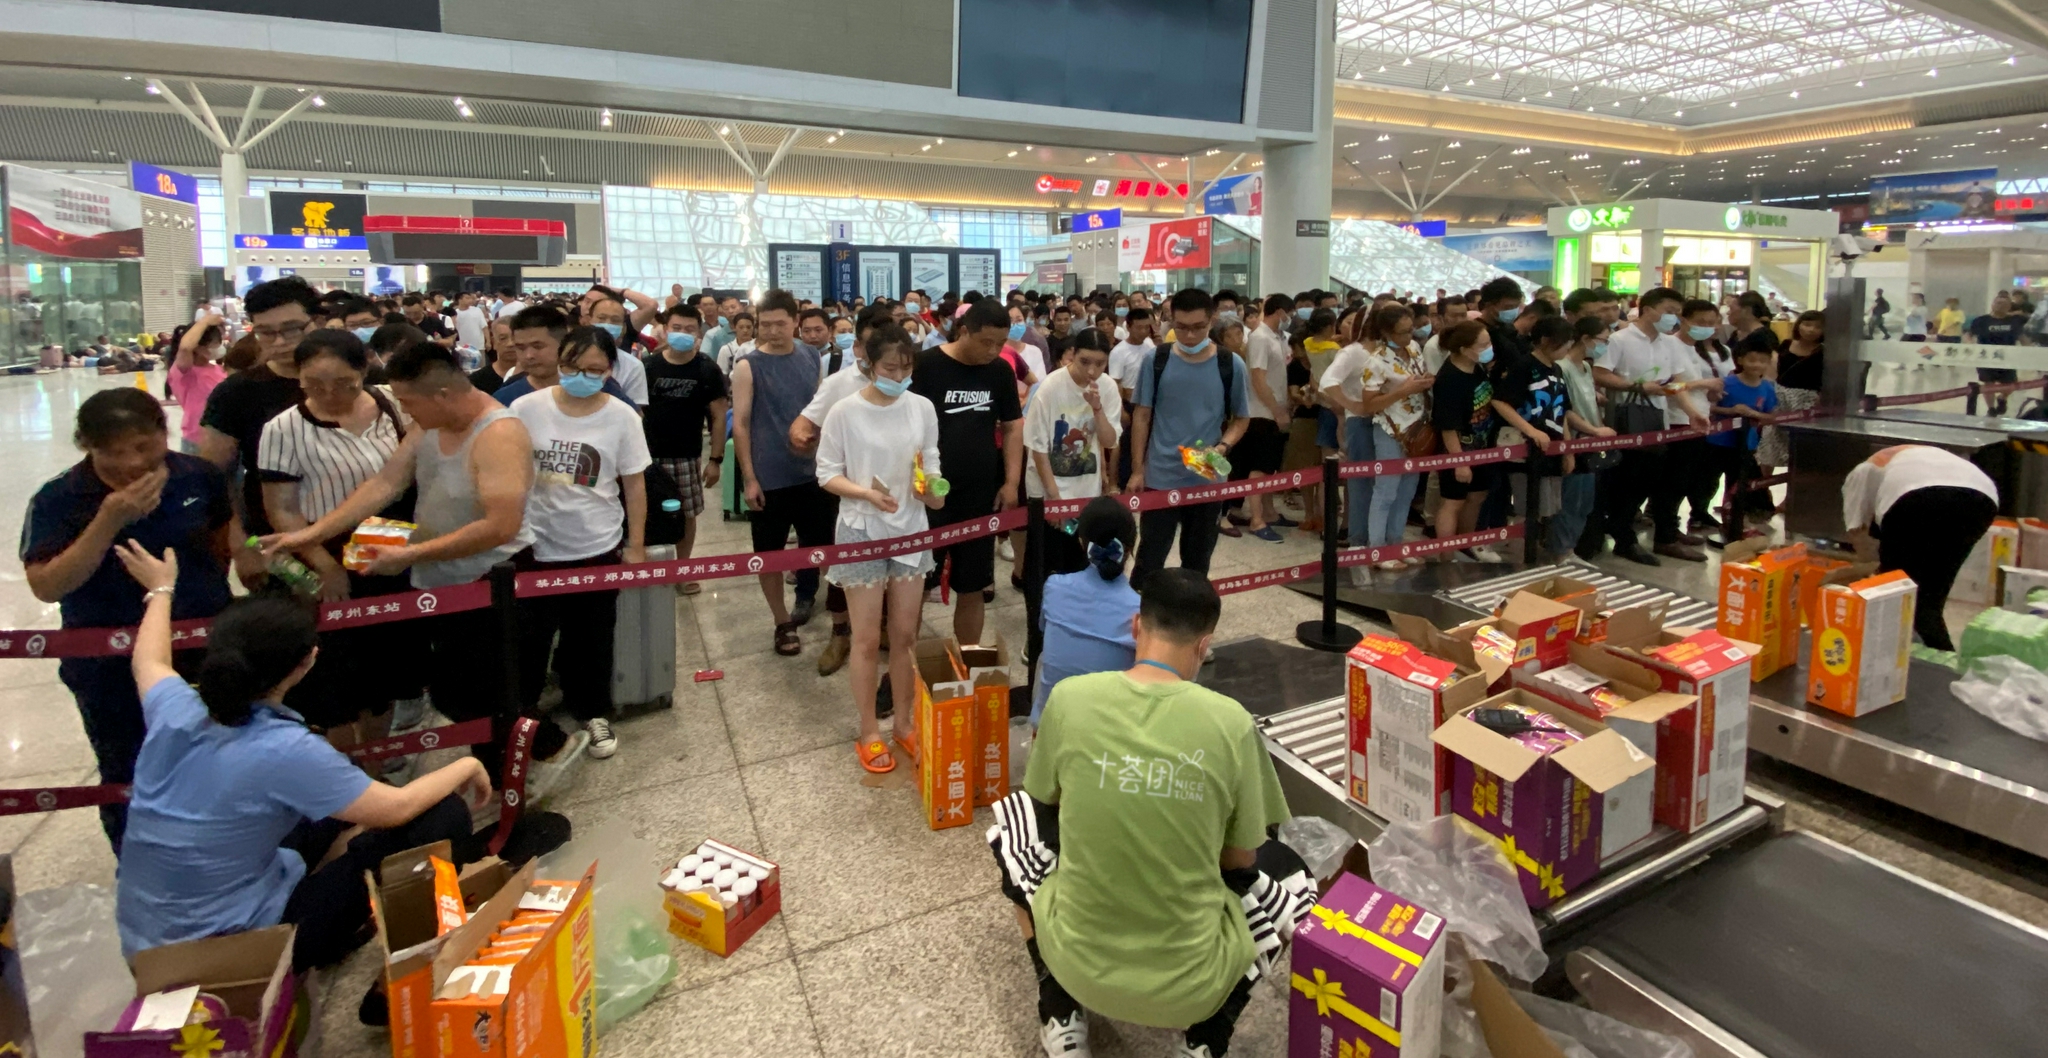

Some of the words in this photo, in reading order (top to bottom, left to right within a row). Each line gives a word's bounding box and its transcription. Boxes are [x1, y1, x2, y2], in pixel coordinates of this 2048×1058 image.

[157, 173, 178, 196] 18A
[1088, 214, 1104, 229] 15A
[836, 250, 850, 262] 3F
[944, 390, 991, 404] REFUSION
[550, 439, 580, 452] THE
[540, 461, 575, 474] FACE
[1186, 488, 1218, 500] 禁止通行
[838, 545, 884, 560] 禁止通行
[888, 535, 934, 552] 郑局集团
[940, 523, 981, 541] 郑州东站
[535, 574, 597, 588] 禁止通行
[603, 567, 667, 583] 郑局集团
[676, 561, 736, 576] 郑州东站
[1724, 572, 1748, 626] 大面块
[326, 601, 401, 622] 郑州东站
[984, 742, 1002, 798] 大面块
[1092, 751, 1175, 798] 十荟团
[947, 759, 966, 820] 大面块
[1174, 790, 1204, 802] TUAN
[1175, 779, 1204, 792] NICE
[440, 895, 463, 933] 面块
